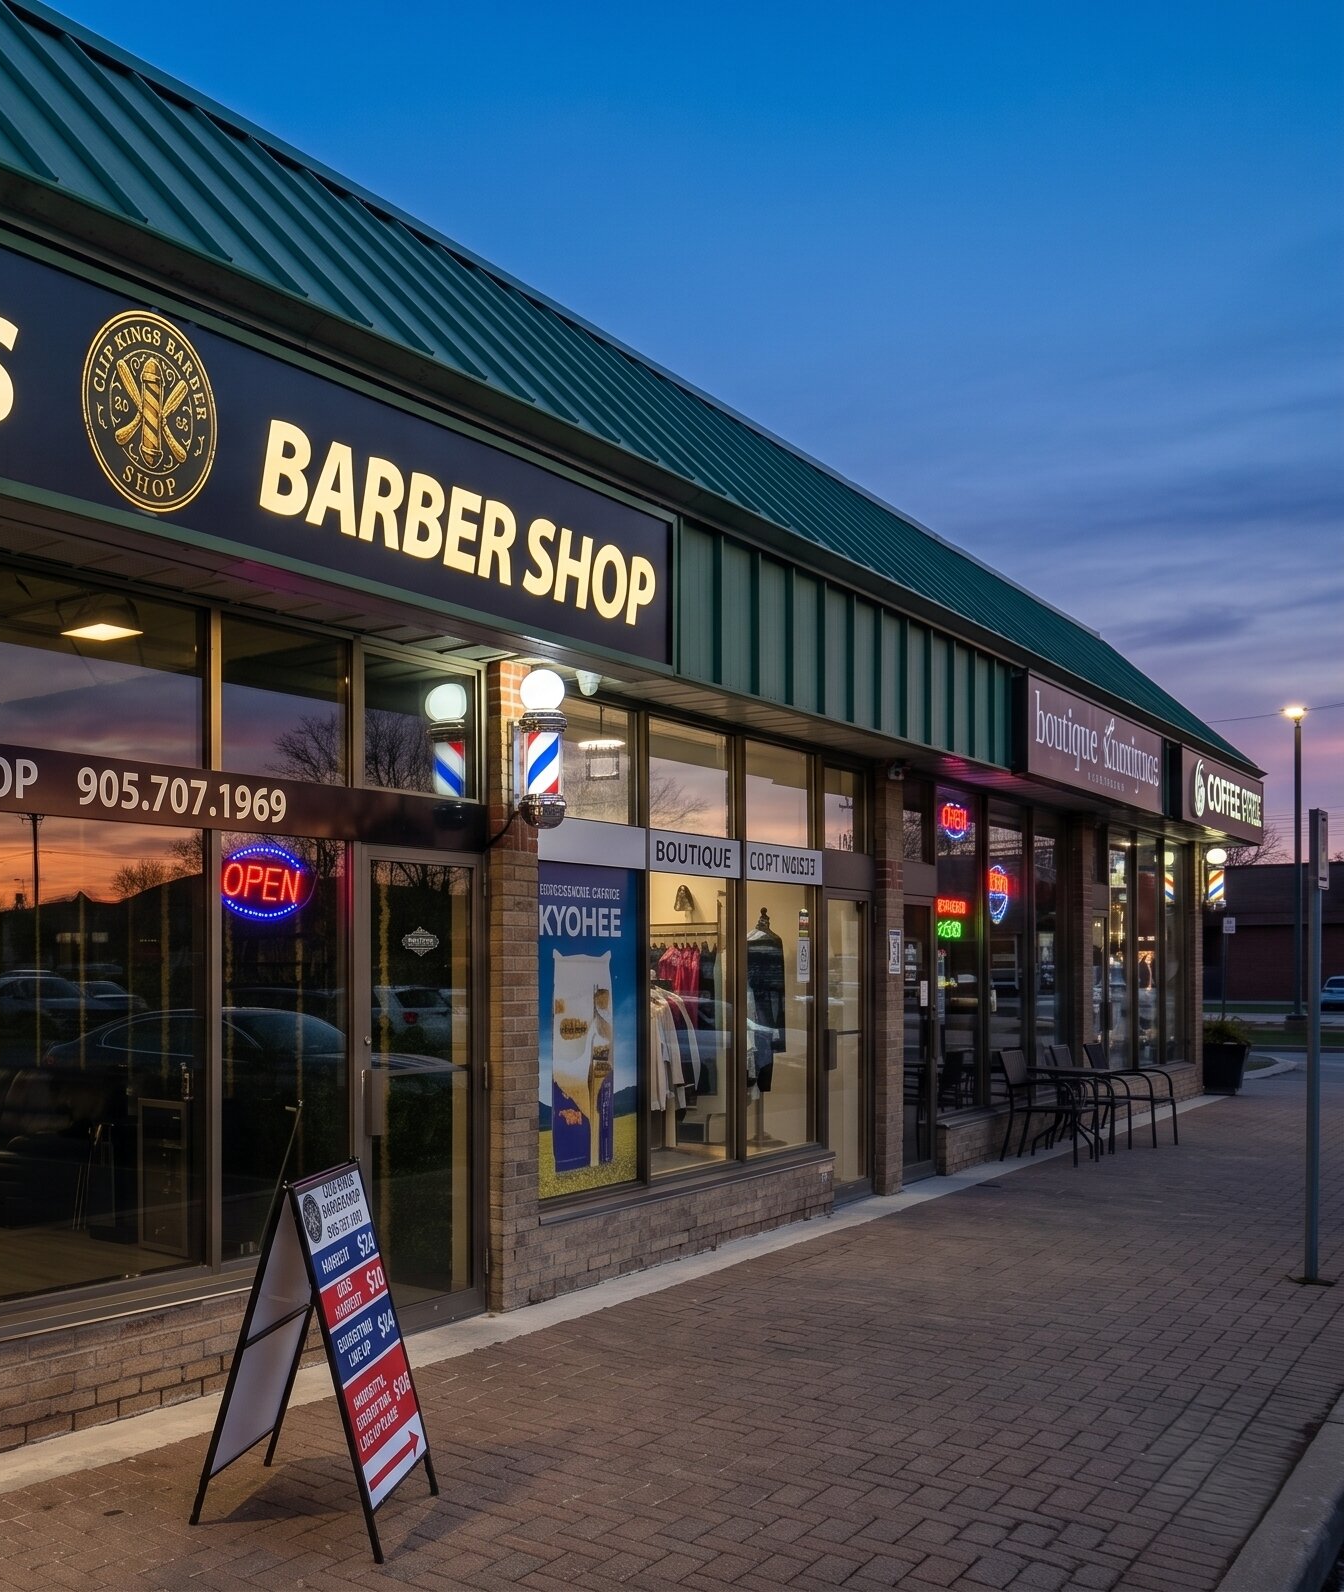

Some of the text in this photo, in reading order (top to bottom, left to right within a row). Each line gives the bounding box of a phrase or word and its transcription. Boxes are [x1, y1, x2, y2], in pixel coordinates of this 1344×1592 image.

[93, 326, 207, 420] CLIP KINGS BARBER
[122, 465, 176, 498] SHOP
[259, 419, 656, 627] BARBER SHOP
[1035, 690, 1098, 771] boutique
[77, 767, 287, 823] 905.707.1969
[1207, 773, 1241, 821] COFFEE
[656, 840, 732, 869] BOUTIQUE
[224, 863, 300, 903] OPEN
[539, 905, 622, 937] KYOHEE
